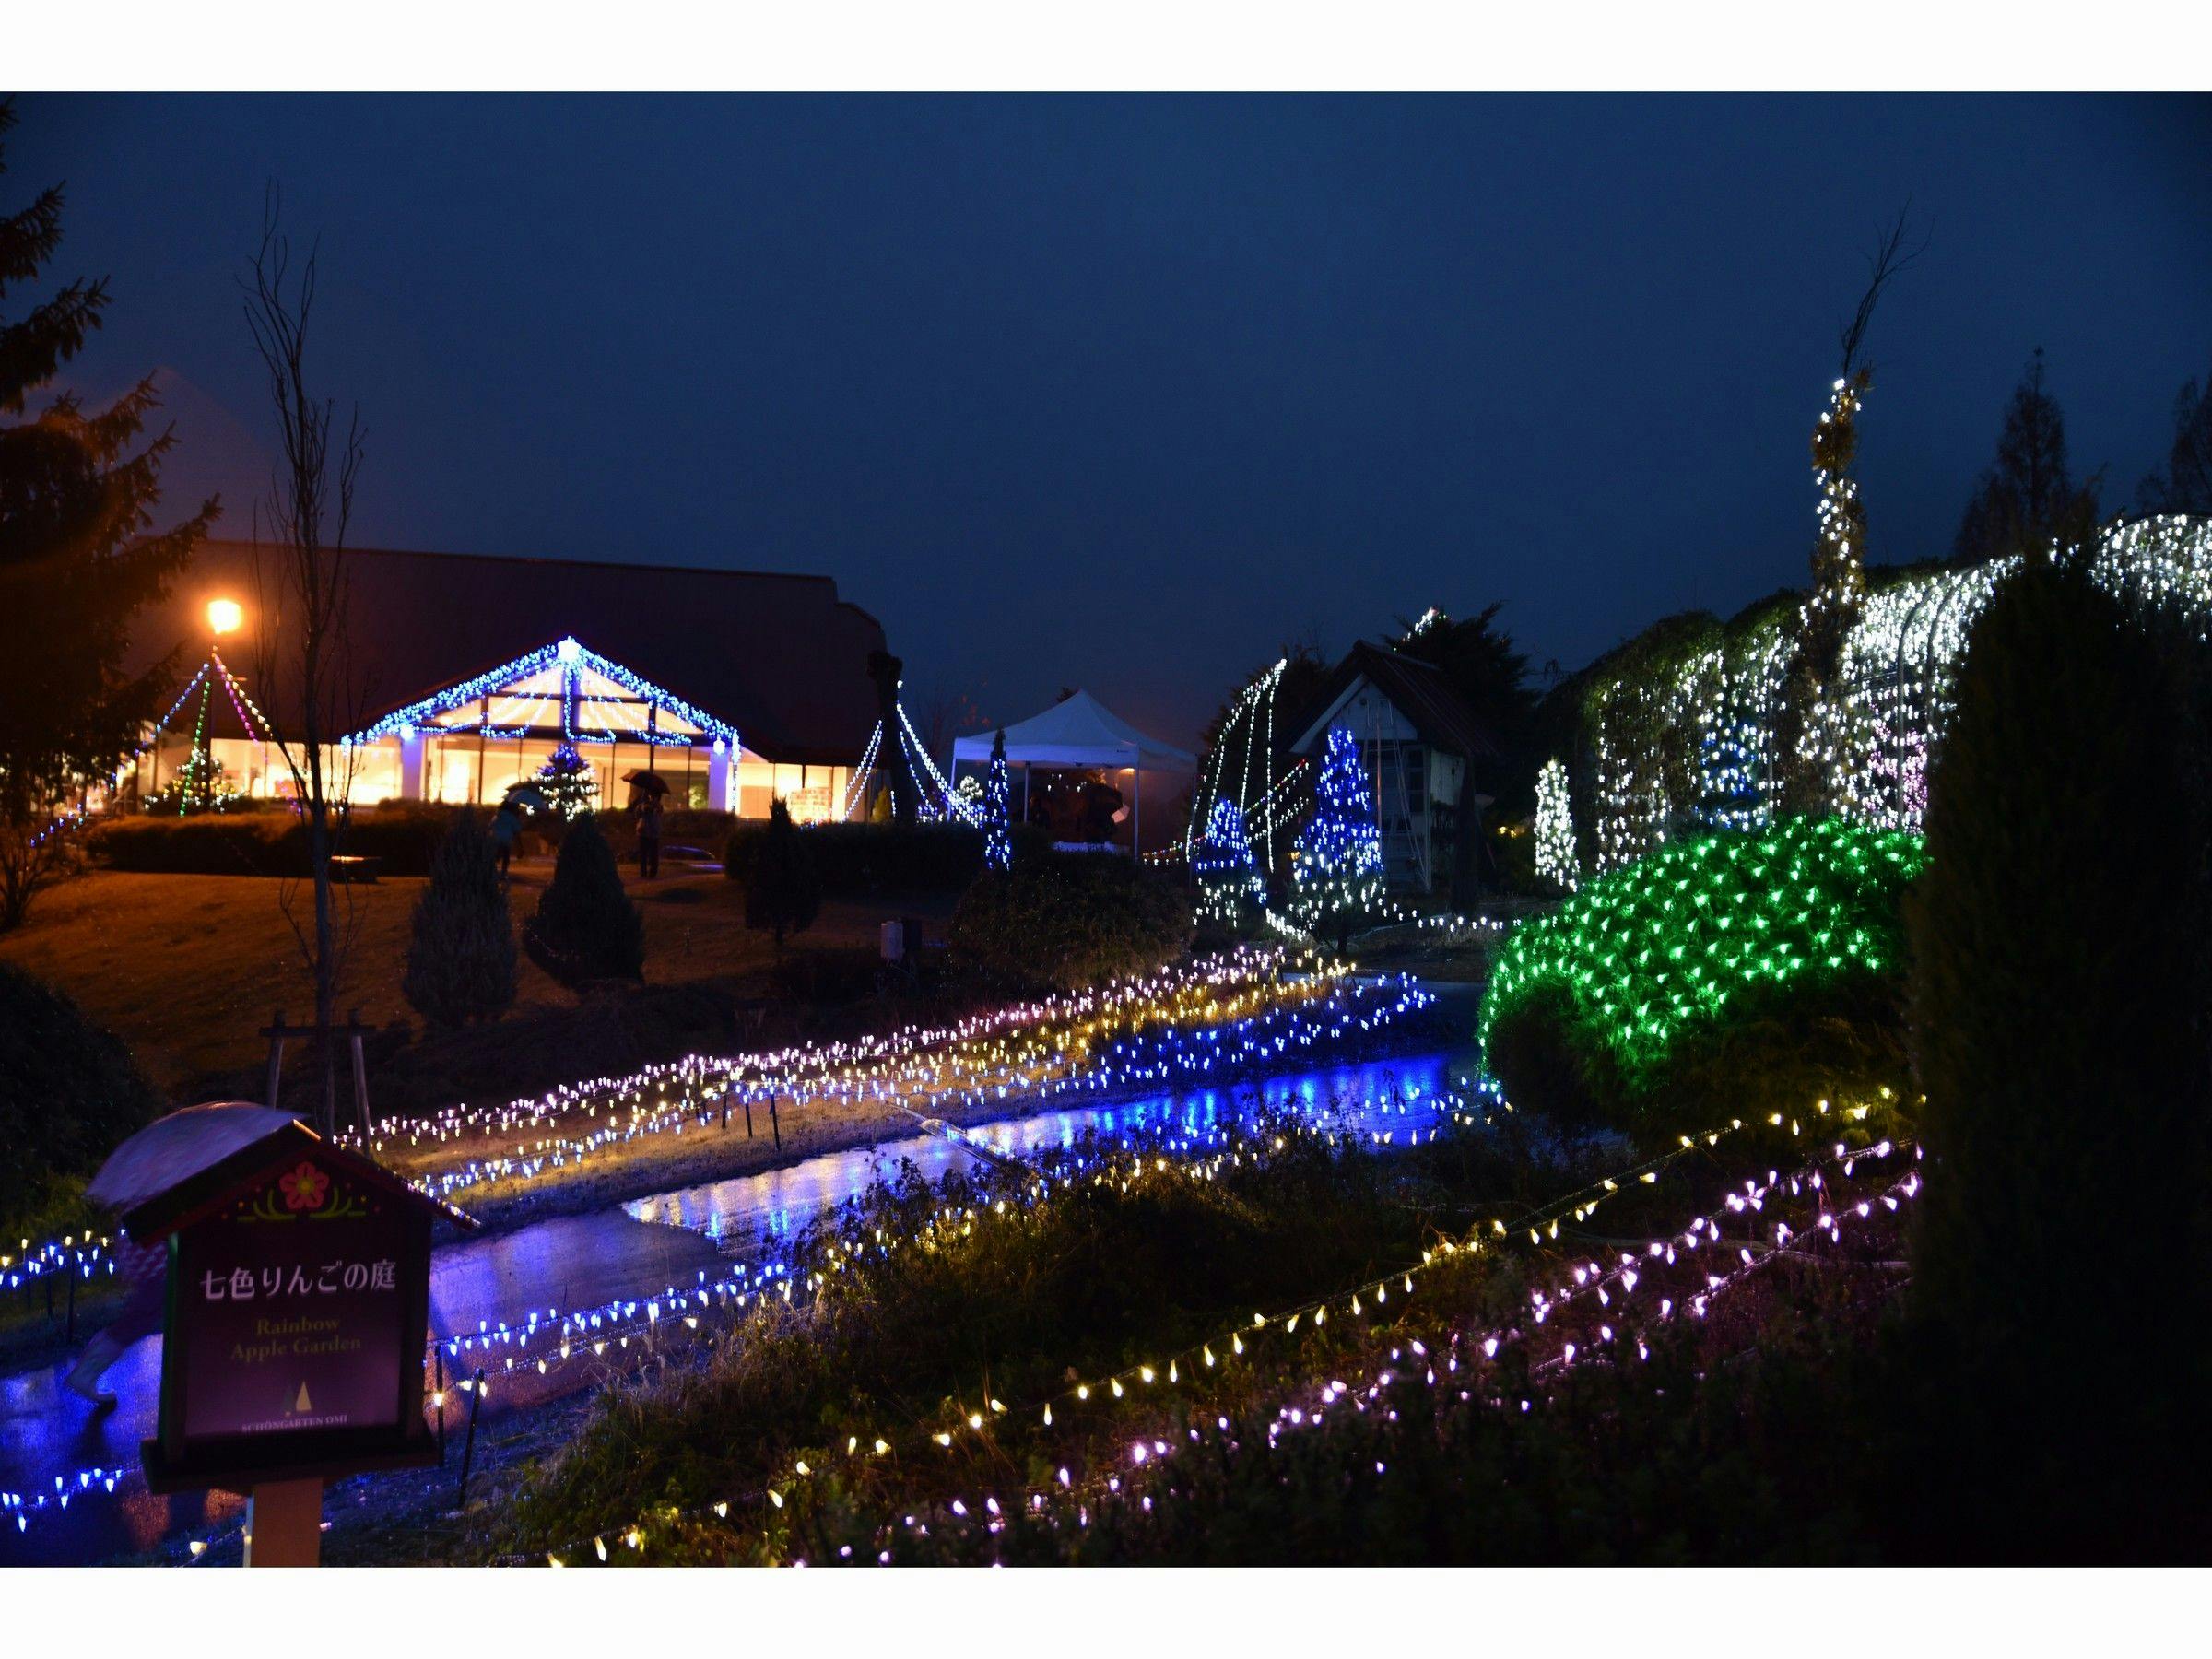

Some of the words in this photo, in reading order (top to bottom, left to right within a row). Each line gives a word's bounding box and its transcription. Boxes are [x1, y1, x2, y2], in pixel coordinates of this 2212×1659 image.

[200, 1259, 396, 1300] 七色りんごの庭
[256, 1316, 340, 1335] Rainbow
[231, 1339, 288, 1363] Apple
[293, 1335, 362, 1354] Garden
[325, 1414, 348, 1425] OMI
